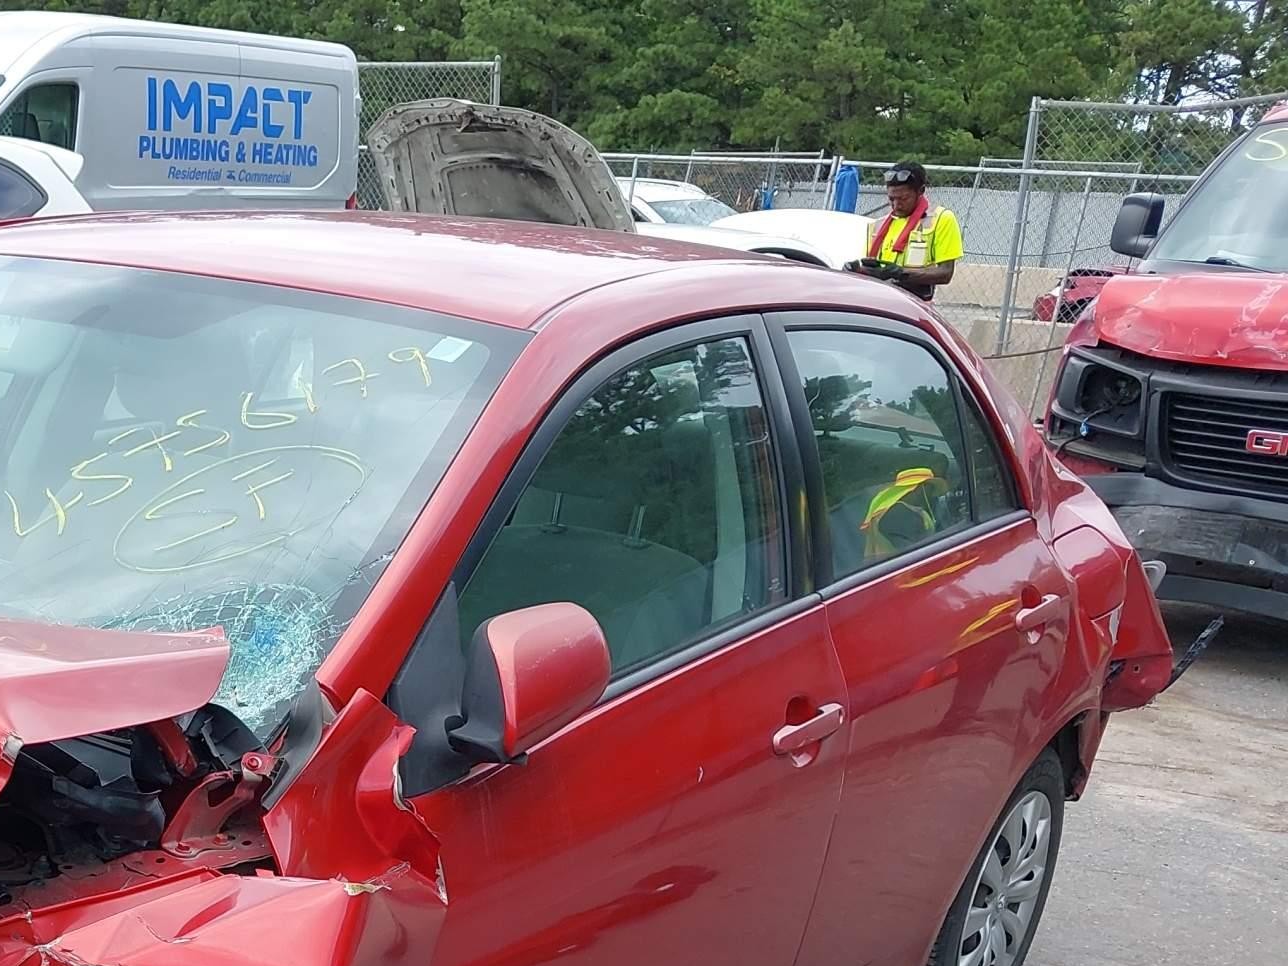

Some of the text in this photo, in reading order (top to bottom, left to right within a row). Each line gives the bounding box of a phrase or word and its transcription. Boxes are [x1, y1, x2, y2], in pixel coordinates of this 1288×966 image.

[147, 77, 312, 140] IMPACT
[138, 135, 318, 167] PLUMBING & HEATING
[167, 166, 292, 185] Residential Commercial
